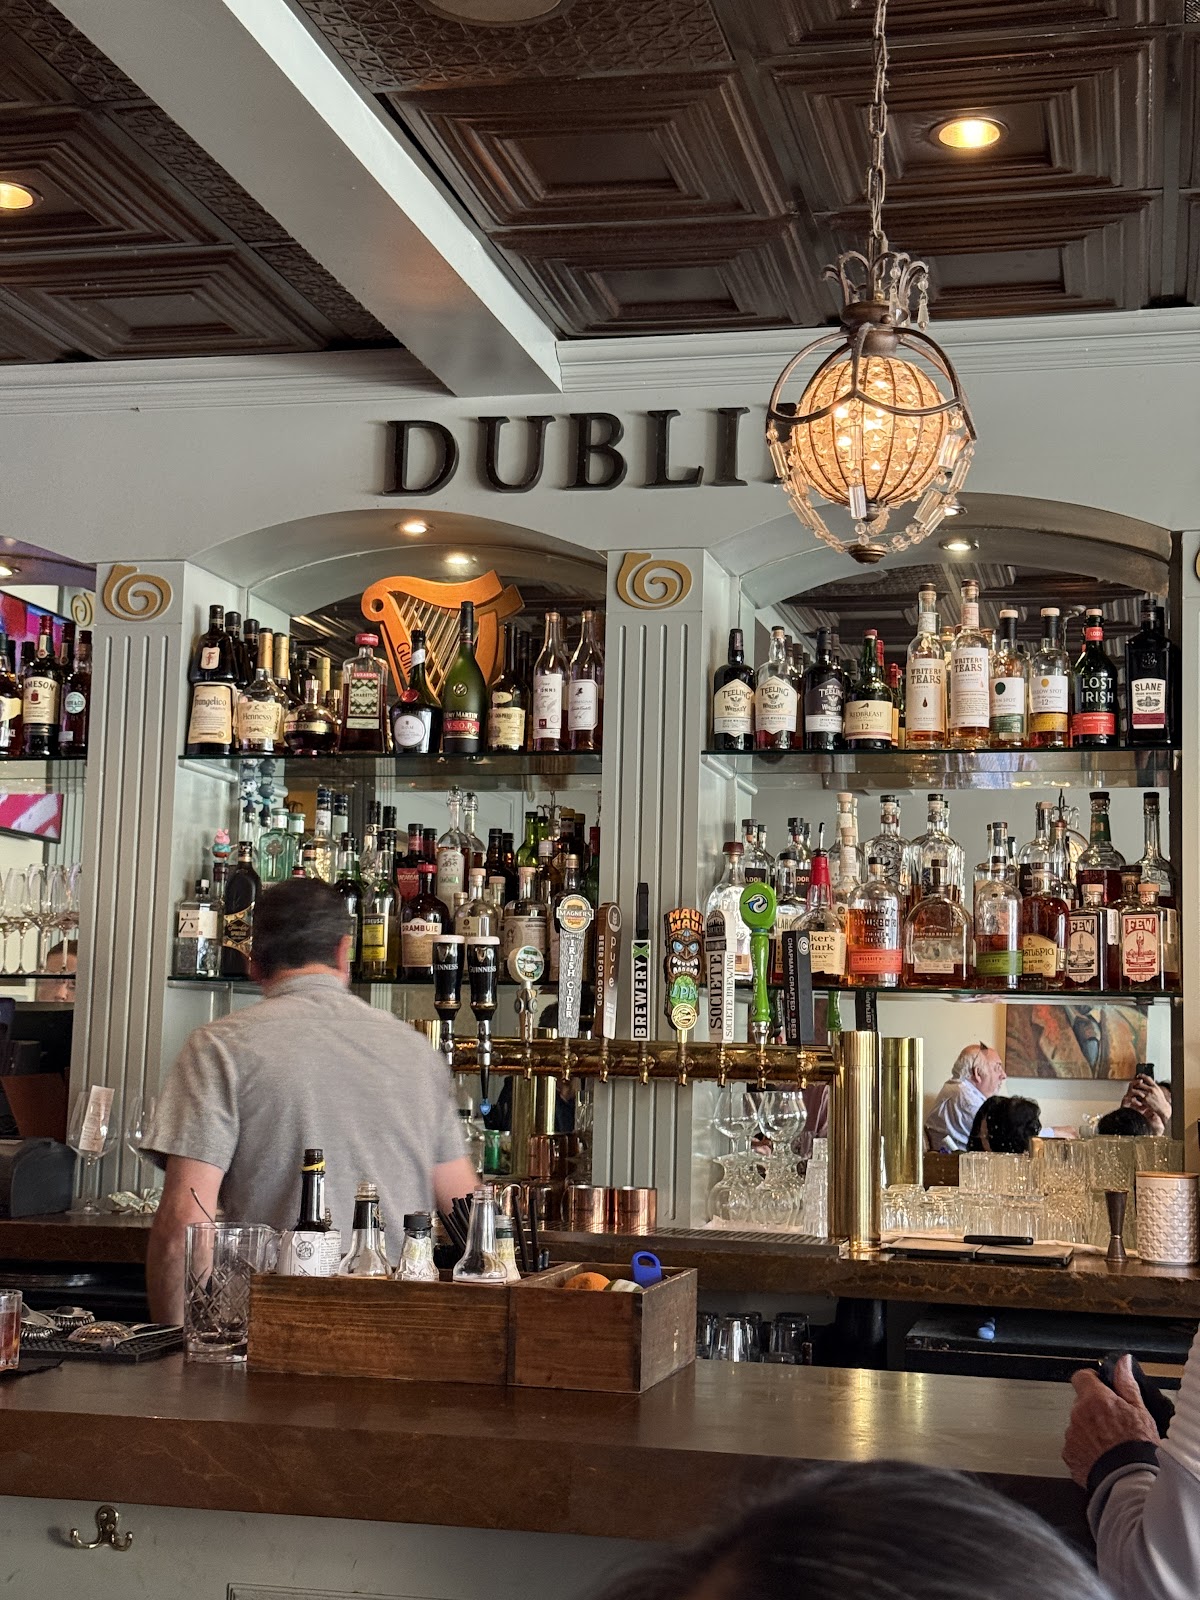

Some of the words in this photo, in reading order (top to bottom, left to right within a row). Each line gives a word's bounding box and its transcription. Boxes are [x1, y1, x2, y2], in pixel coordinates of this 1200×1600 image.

[382, 406, 787, 497] DUBLI
[954, 664, 983, 673] TEARS
[911, 675, 941, 685] TEARS
[1082, 677, 1114, 690] LOST
[761, 686, 790, 697] TEELING
[818, 688, 844, 699] TEELING
[1134, 683, 1163, 692] SLANE
[722, 689, 751, 700] TEELING
[1081, 691, 1115, 704] IRISH
[242, 712, 273, 721] Hennessy
[455, 711, 479, 719] MARTIN
[558, 909, 592, 917] MAGNERS
[669, 907, 703, 922] MAUI
[402, 924, 439, 933] DRAMBUIE
[671, 918, 703, 933] WAUI
[1070, 919, 1093, 934] FEW
[1128, 918, 1154, 933] FEW
[810, 934, 835, 943] ker's
[567, 939, 576, 977] IRISH
[608, 936, 617, 988] pure
[787, 938, 795, 977] CHAPMAN
[434, 963, 458, 971] UINNESS
[469, 965, 497, 973] GUINNESS
[725, 952, 735, 997] BREWING
[634, 959, 647, 1037] BREWERY
[671, 985, 698, 1000] IPA
[709, 953, 723, 1030] SOCIETE
[565, 981, 575, 1018] CIDER
[725, 999, 734, 1038] SOCIETE
